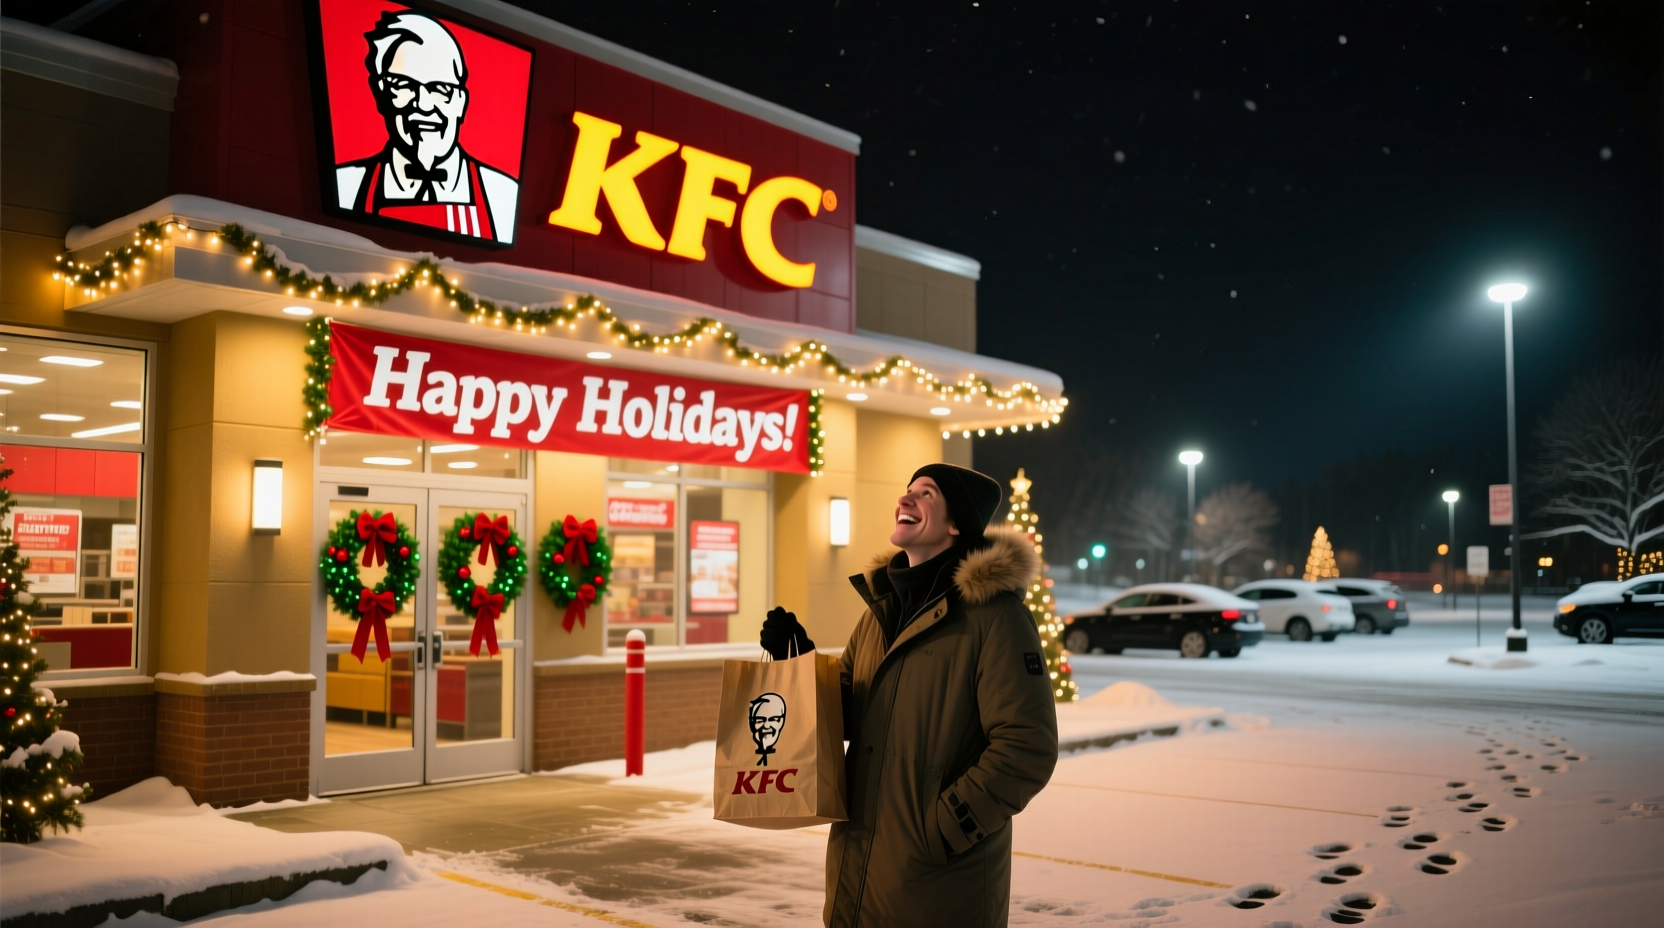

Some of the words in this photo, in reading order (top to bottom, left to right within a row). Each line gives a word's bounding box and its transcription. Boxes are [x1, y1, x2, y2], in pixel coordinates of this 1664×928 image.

[548, 110, 823, 288] KFC
[362, 345, 568, 444] Happy
[575, 375, 799, 463] Holidays!
[731, 768, 798, 795] KFC
